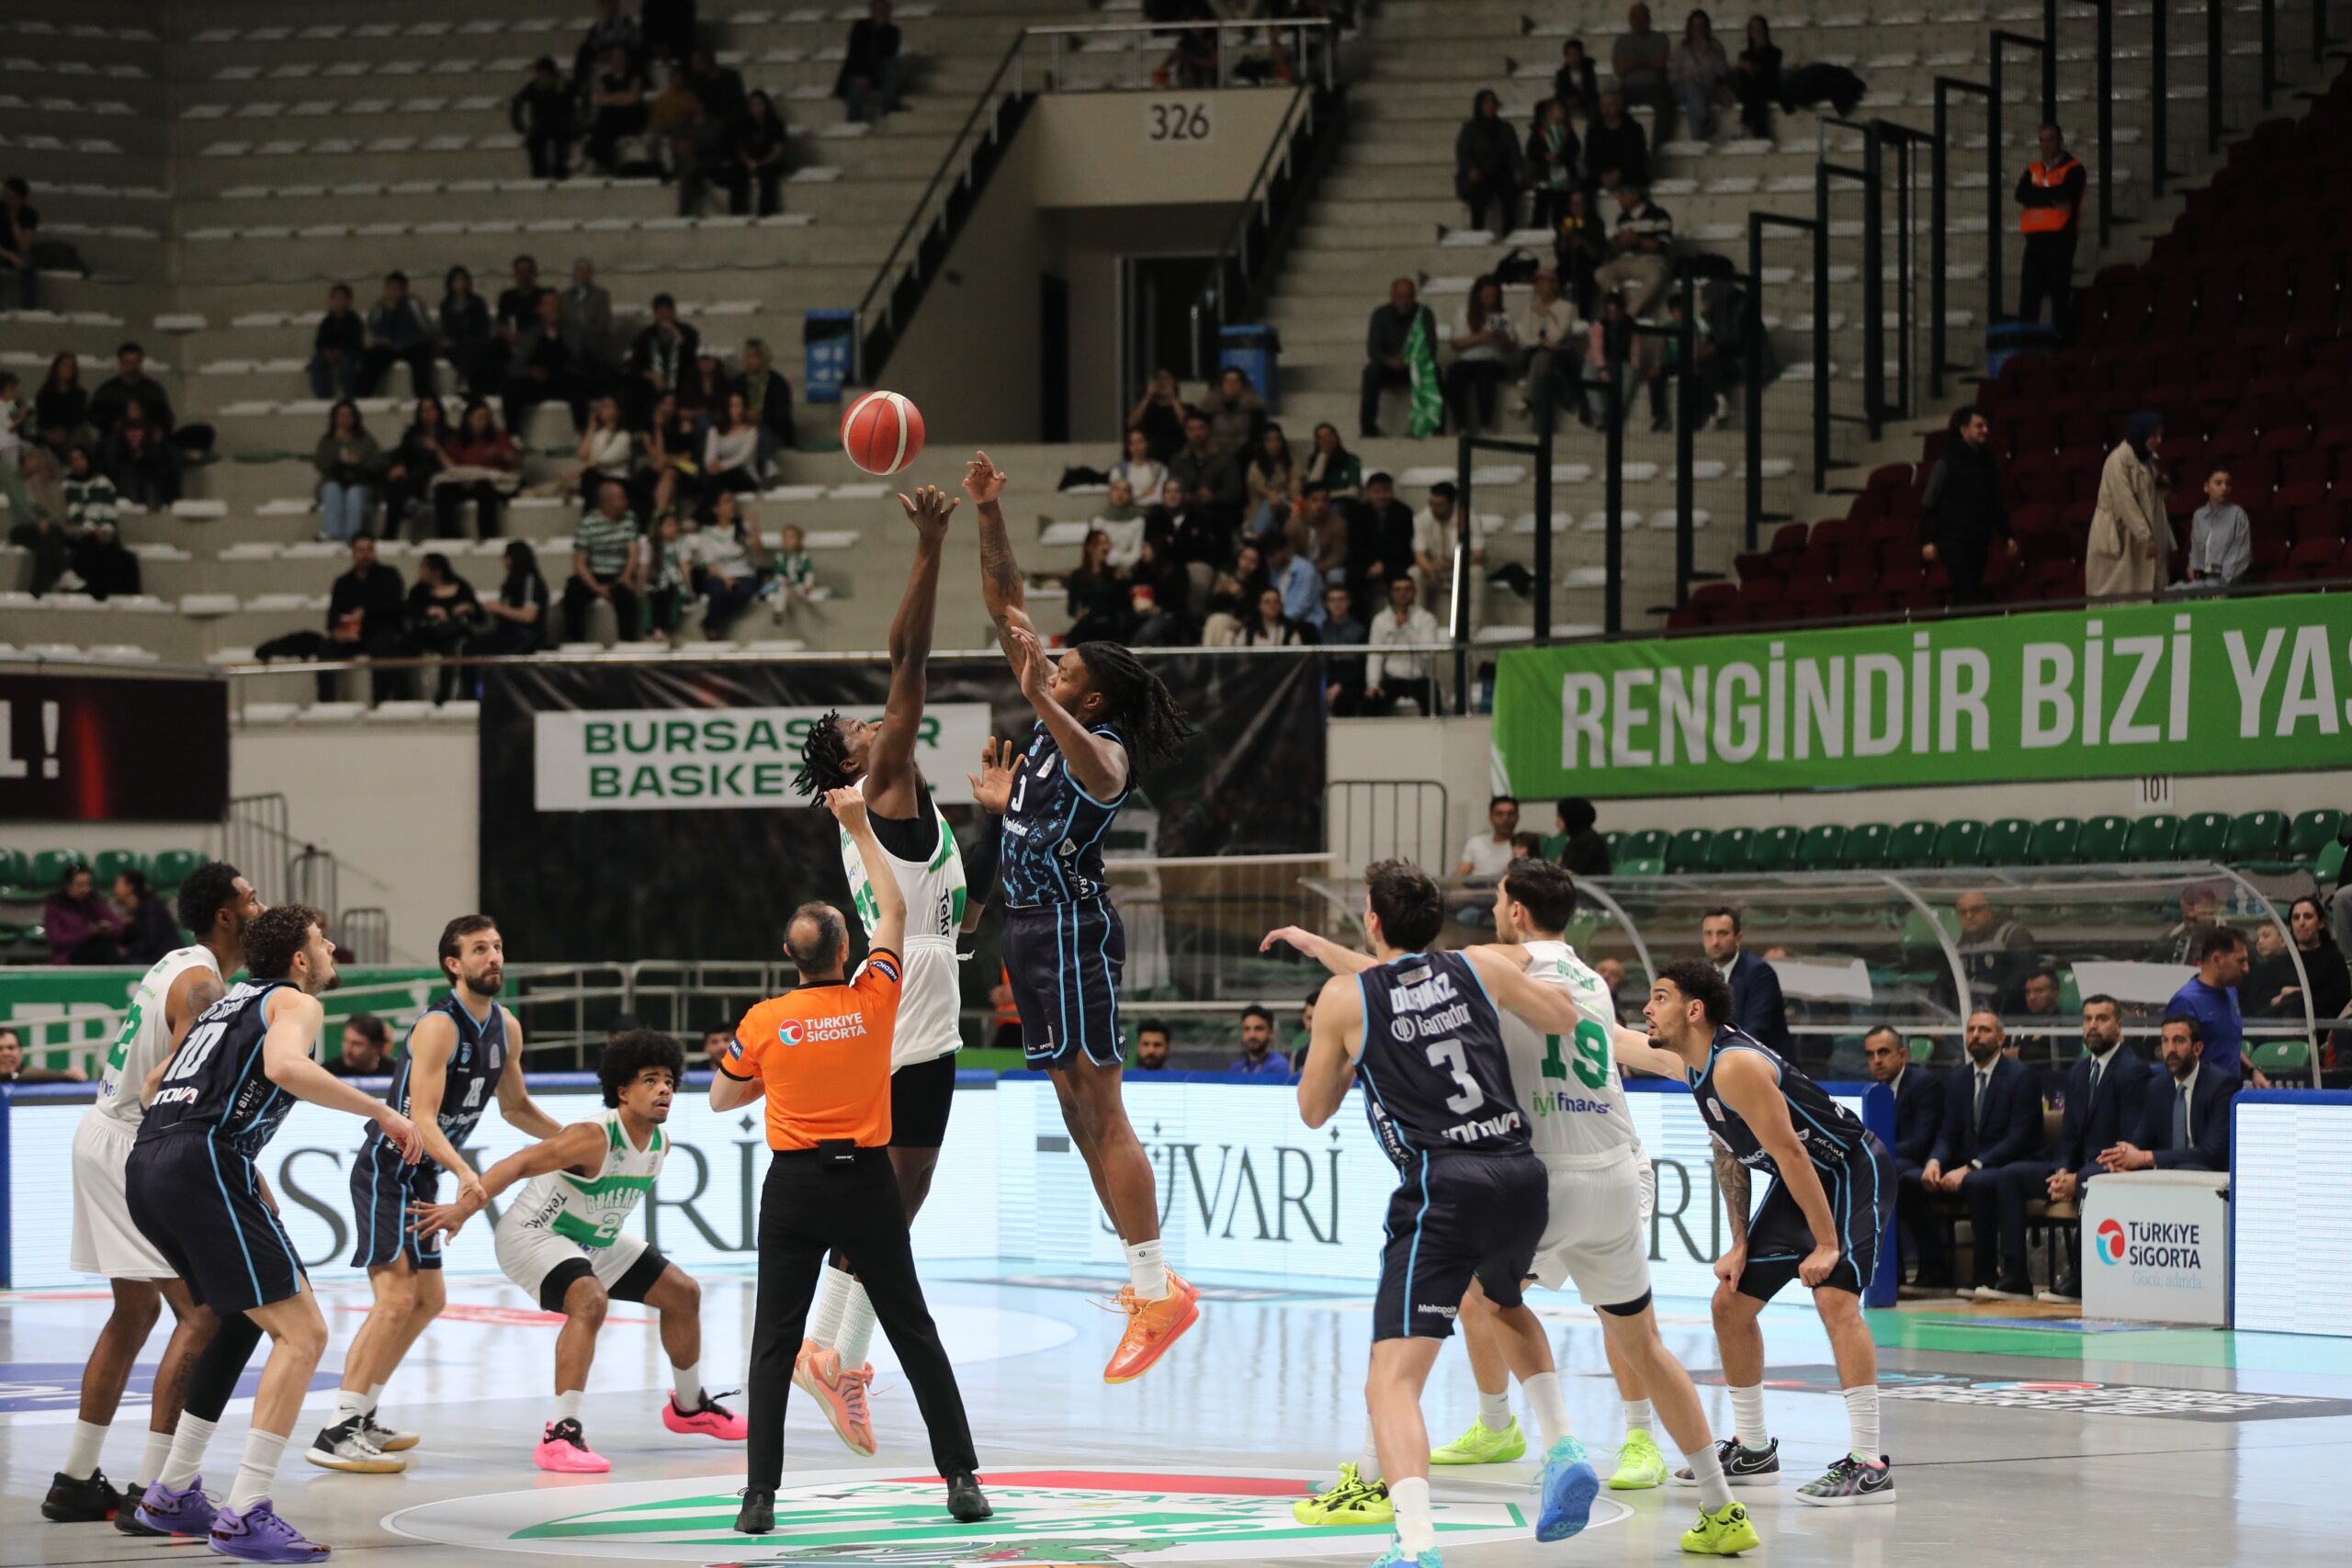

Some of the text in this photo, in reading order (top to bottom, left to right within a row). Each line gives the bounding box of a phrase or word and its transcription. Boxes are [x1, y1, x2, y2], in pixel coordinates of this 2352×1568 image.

[1149, 103, 1210, 141] 326
[1560, 613, 2352, 771] RENGİNDİR BİZİ YA
[583, 716, 943, 754] BURSASR
[2142, 774, 2168, 804] 101
[805, 1011, 864, 1030] TÜRKİYE
[806, 1024, 867, 1043] SİGORTA
[162, 1021, 229, 1082] 10
[1541, 1018, 1609, 1090] 19
[1425, 1038, 1485, 1115] 3
[1101, 1122, 1343, 1246] ÜVARİ
[2129, 1221, 2200, 1245] TÜRKİYE
[2129, 1245, 2201, 1269] SİGORTA
